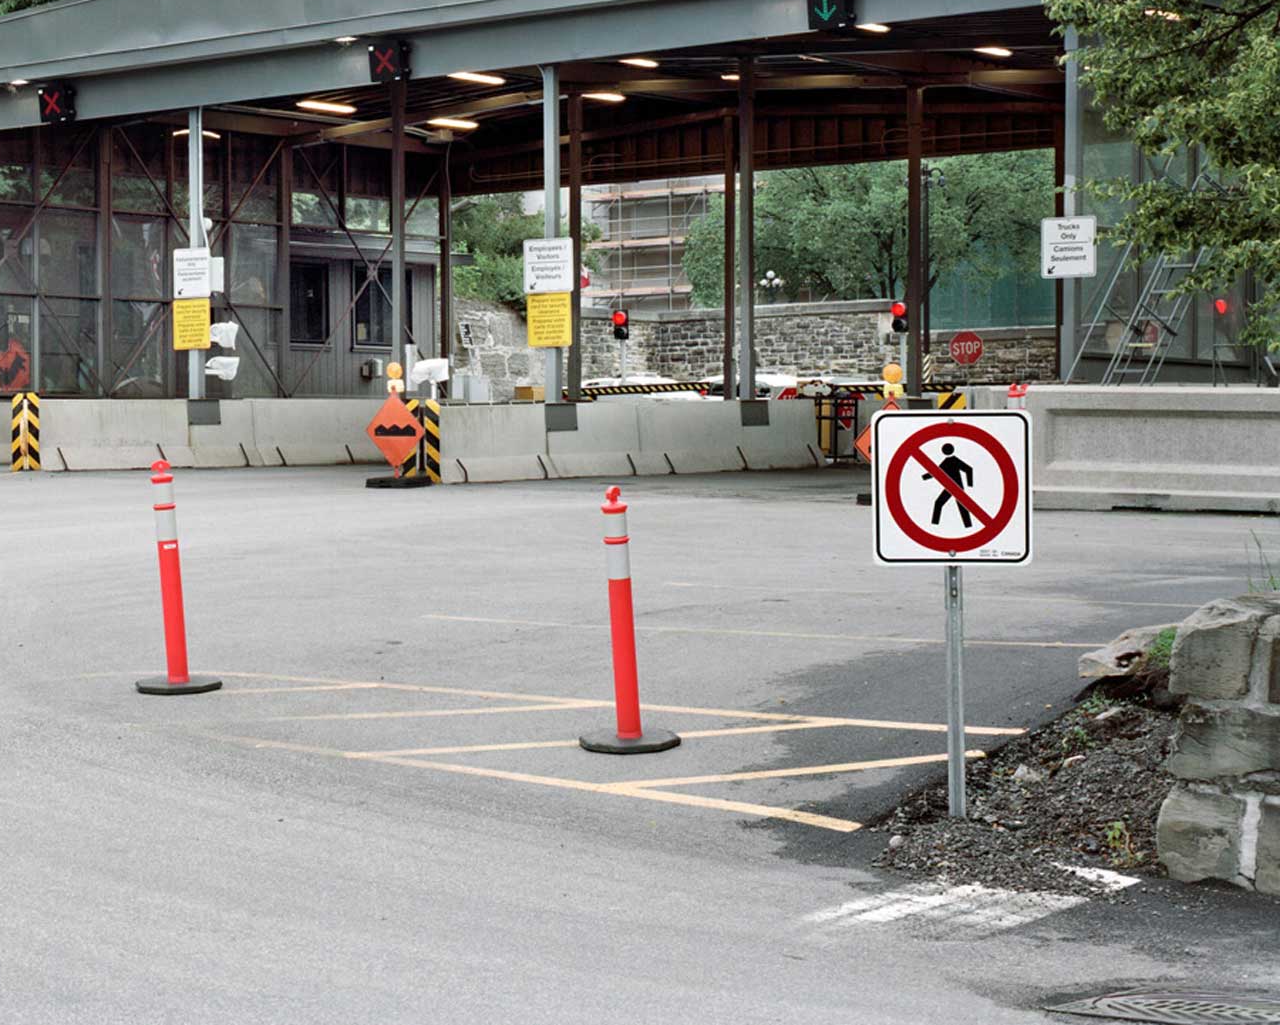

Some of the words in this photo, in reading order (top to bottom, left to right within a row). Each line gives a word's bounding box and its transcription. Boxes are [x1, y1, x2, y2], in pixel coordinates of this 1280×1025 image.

[1060, 232, 1077, 240] Only
[1050, 254, 1087, 262] Seulement
[953, 341, 981, 355] STOP
